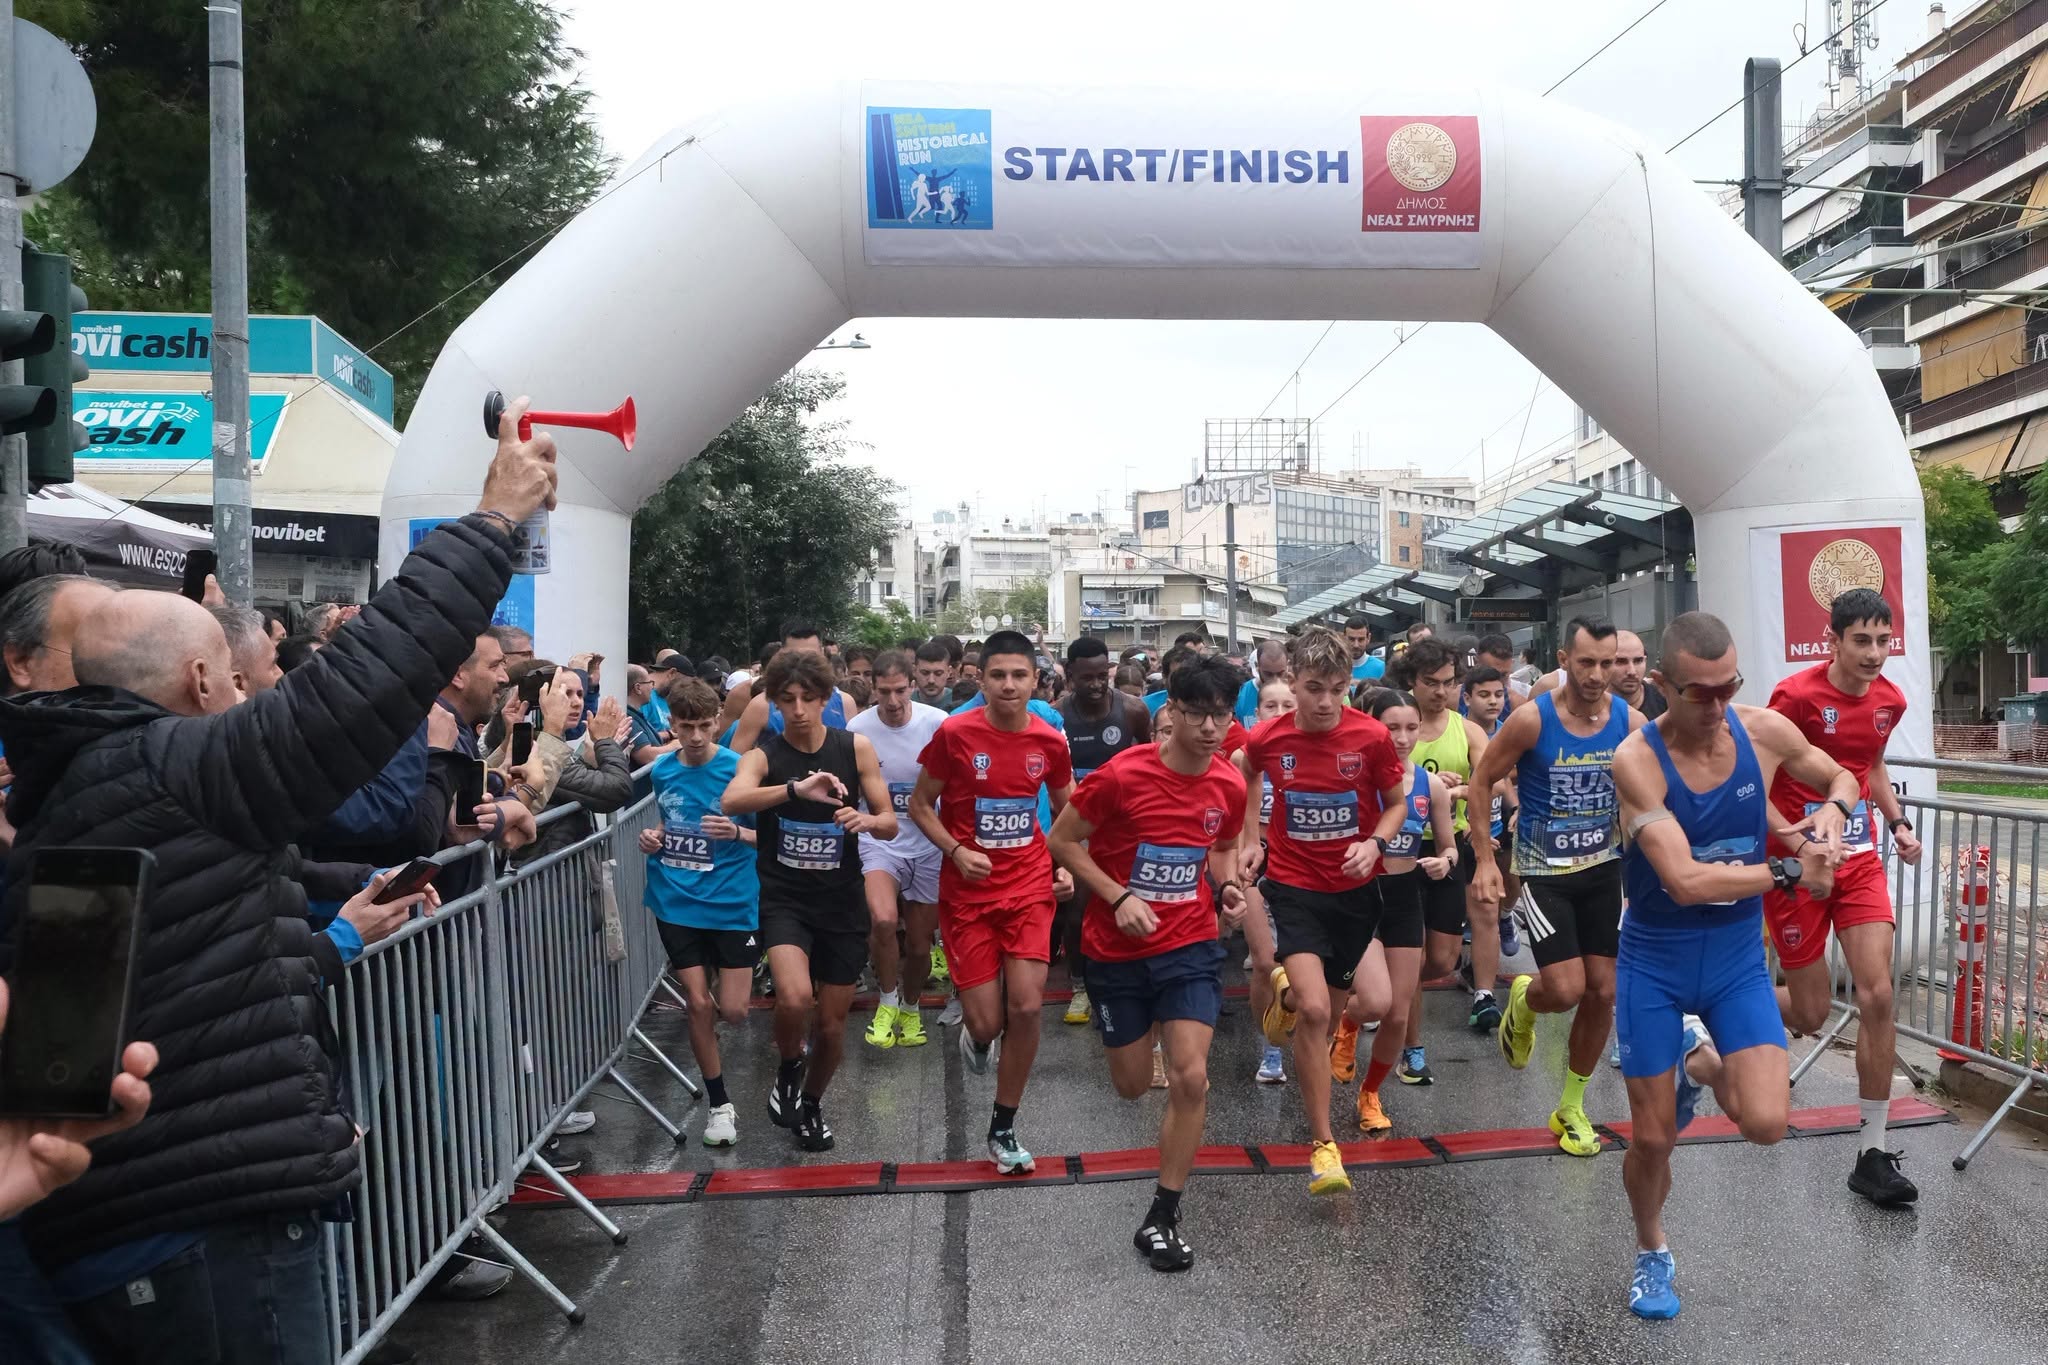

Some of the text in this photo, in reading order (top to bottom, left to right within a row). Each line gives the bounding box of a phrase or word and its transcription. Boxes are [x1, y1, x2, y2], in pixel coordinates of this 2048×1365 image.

[896, 132, 988, 152] HISTORICAL
[898, 150, 932, 166] RUN
[1003, 146, 1349, 184] START/FINISH
[1396, 197, 1447, 210] ΔΗΜΟΣ
[1366, 214, 1475, 227] ΝΕΑΣ ΣΜΥΡΝΗΣ
[80, 325, 113, 334] novibet
[71, 327, 209, 359] ovicash
[73, 402, 165, 427] ovi
[88, 400, 148, 409] novibet
[87, 421, 186, 445] ash
[251, 522, 326, 543] novibet
[118, 543, 188, 577] www.espo
[1838, 575, 1861, 587] 1922
[1790, 642, 1831, 656] ΝΕΑΣ
[980, 812, 1030, 831] 5306
[1292, 806, 1352, 825] 5308
[665, 834, 708, 855] 5712
[783, 833, 837, 854] 5582
[1555, 828, 1605, 849] 6156
[1139, 862, 1197, 884] 5309
